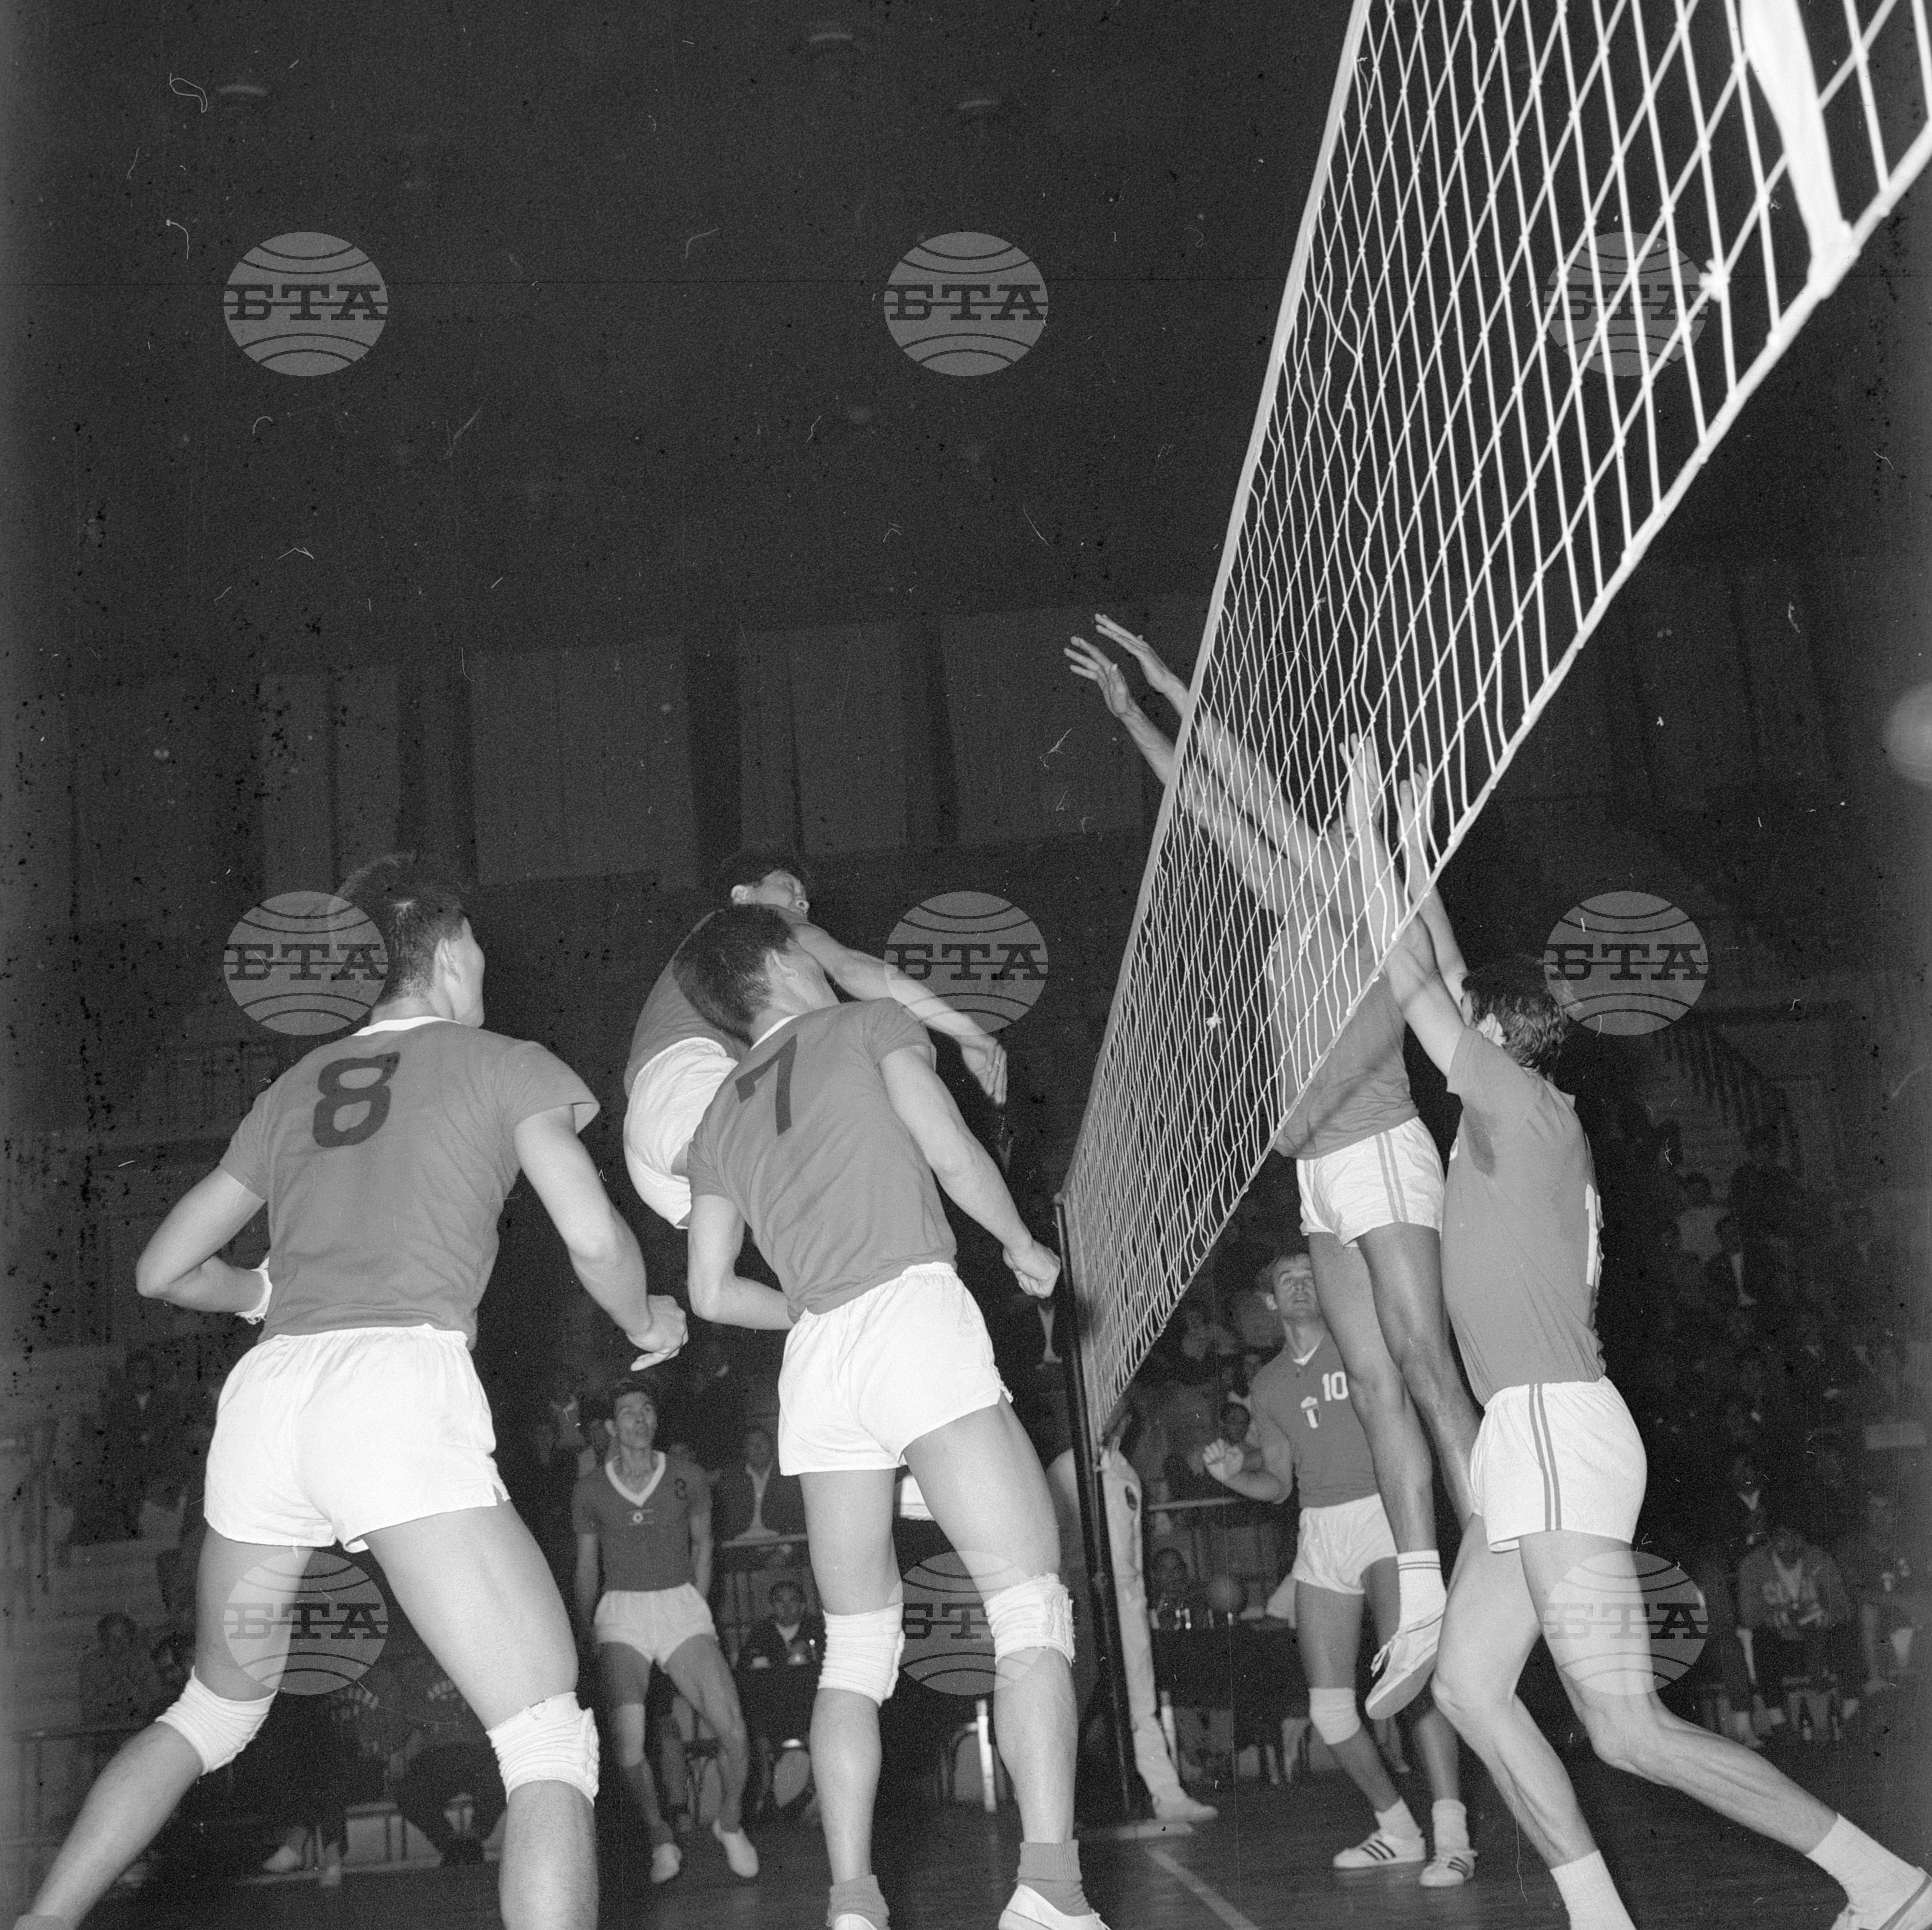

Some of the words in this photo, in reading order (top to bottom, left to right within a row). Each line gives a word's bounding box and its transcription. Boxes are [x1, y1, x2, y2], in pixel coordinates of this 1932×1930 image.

[313, 1051, 400, 1148] 8
[735, 1033, 797, 1136] 7
[1322, 1372, 1349, 1401] 10
